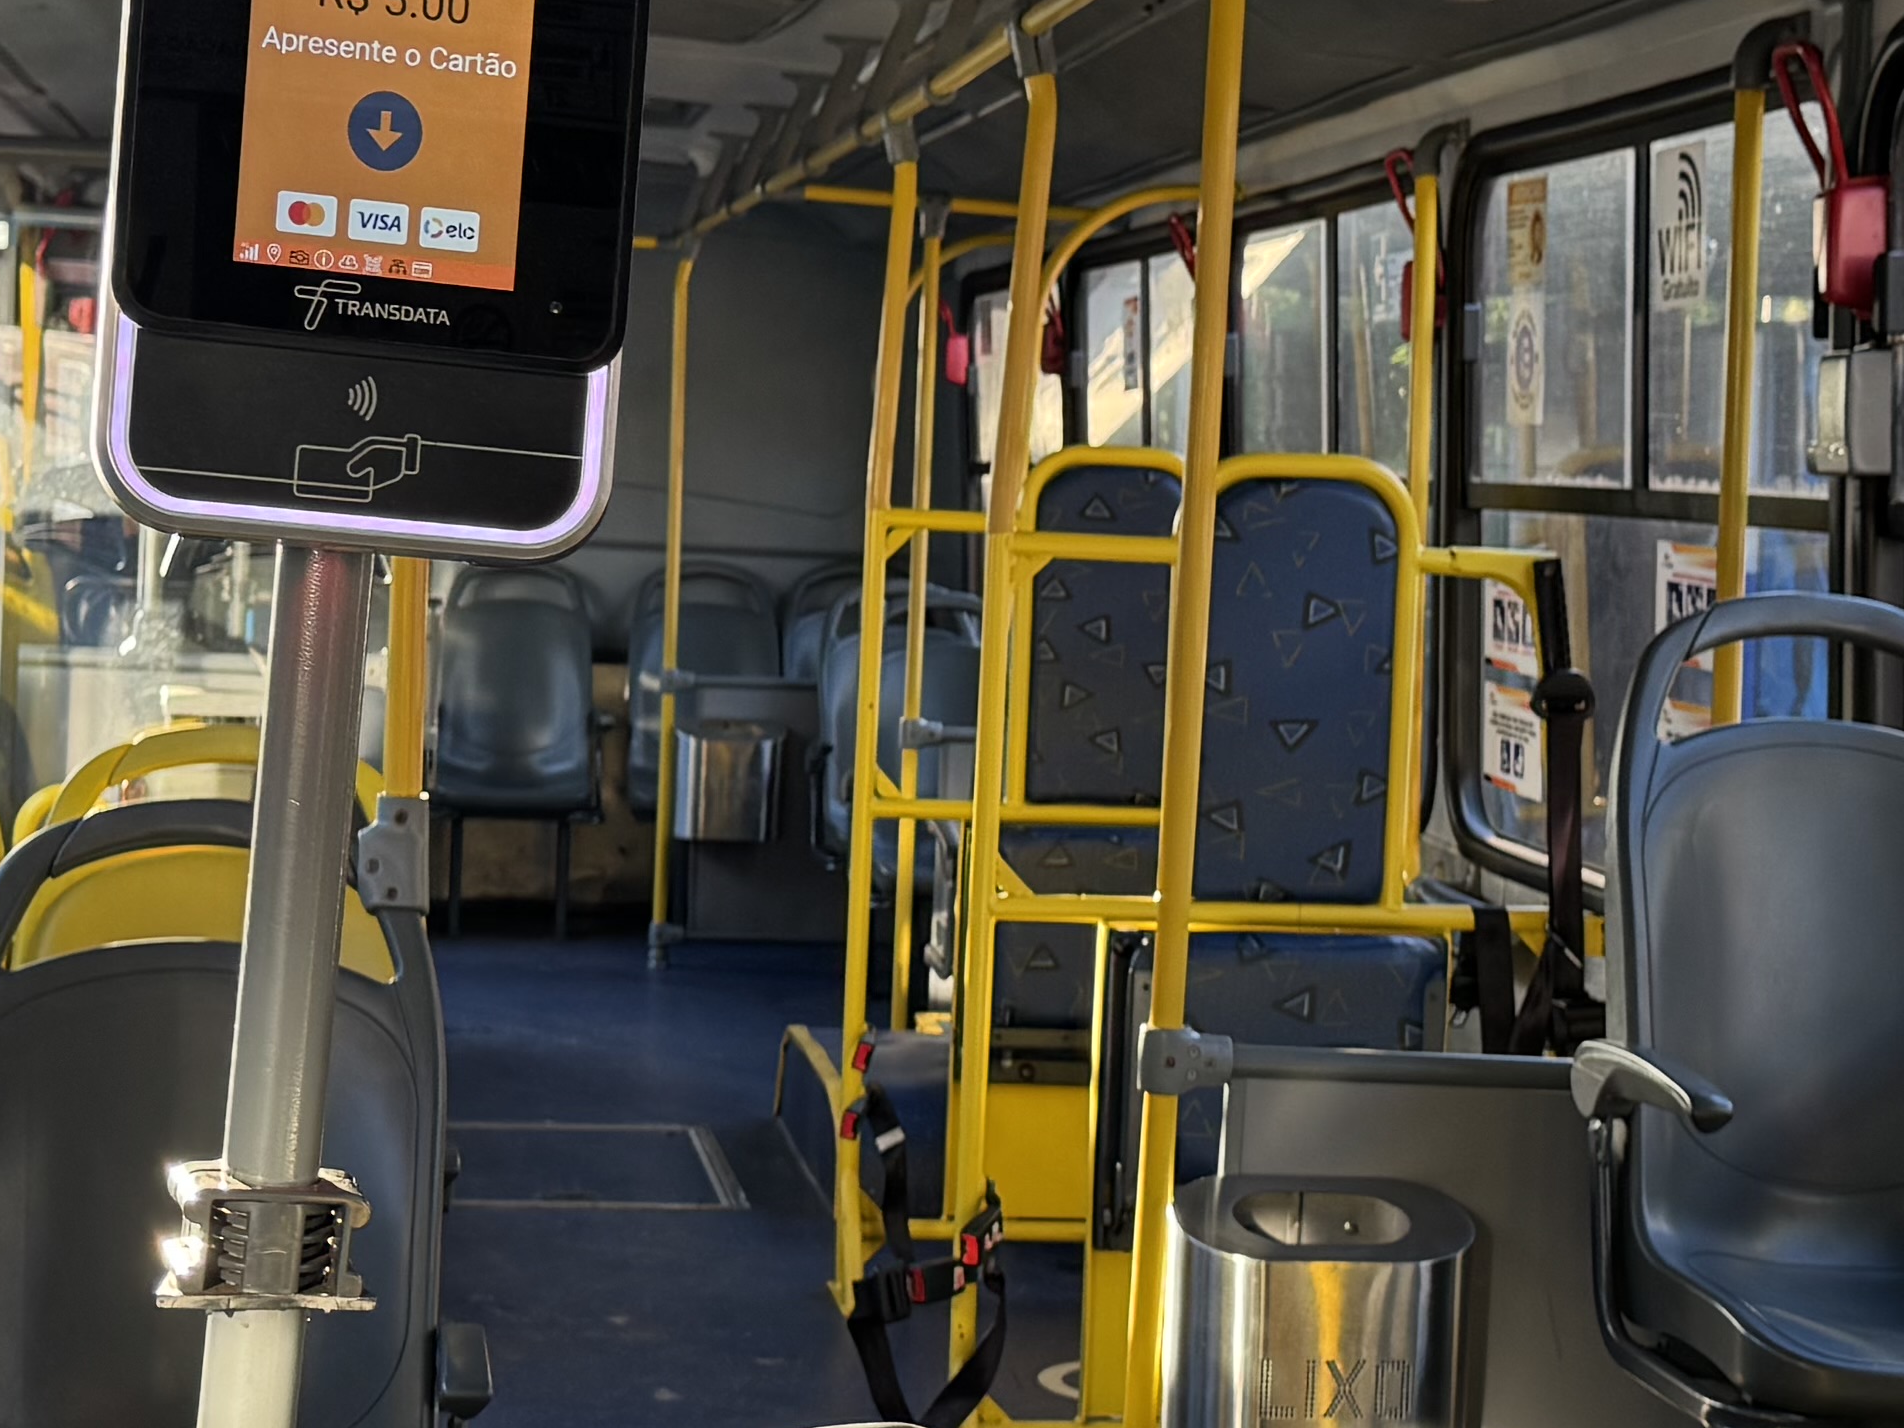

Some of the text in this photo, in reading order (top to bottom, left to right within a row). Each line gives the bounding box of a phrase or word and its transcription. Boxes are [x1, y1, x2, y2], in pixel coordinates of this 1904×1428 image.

[262, 25, 517, 78] Apresente o Cartão
[356, 210, 402, 233] VISA
[1661, 276, 1700, 301] Gratuito
[335, 298, 450, 326] TRANSDATA
[1259, 1358, 1414, 1421] LIXO
